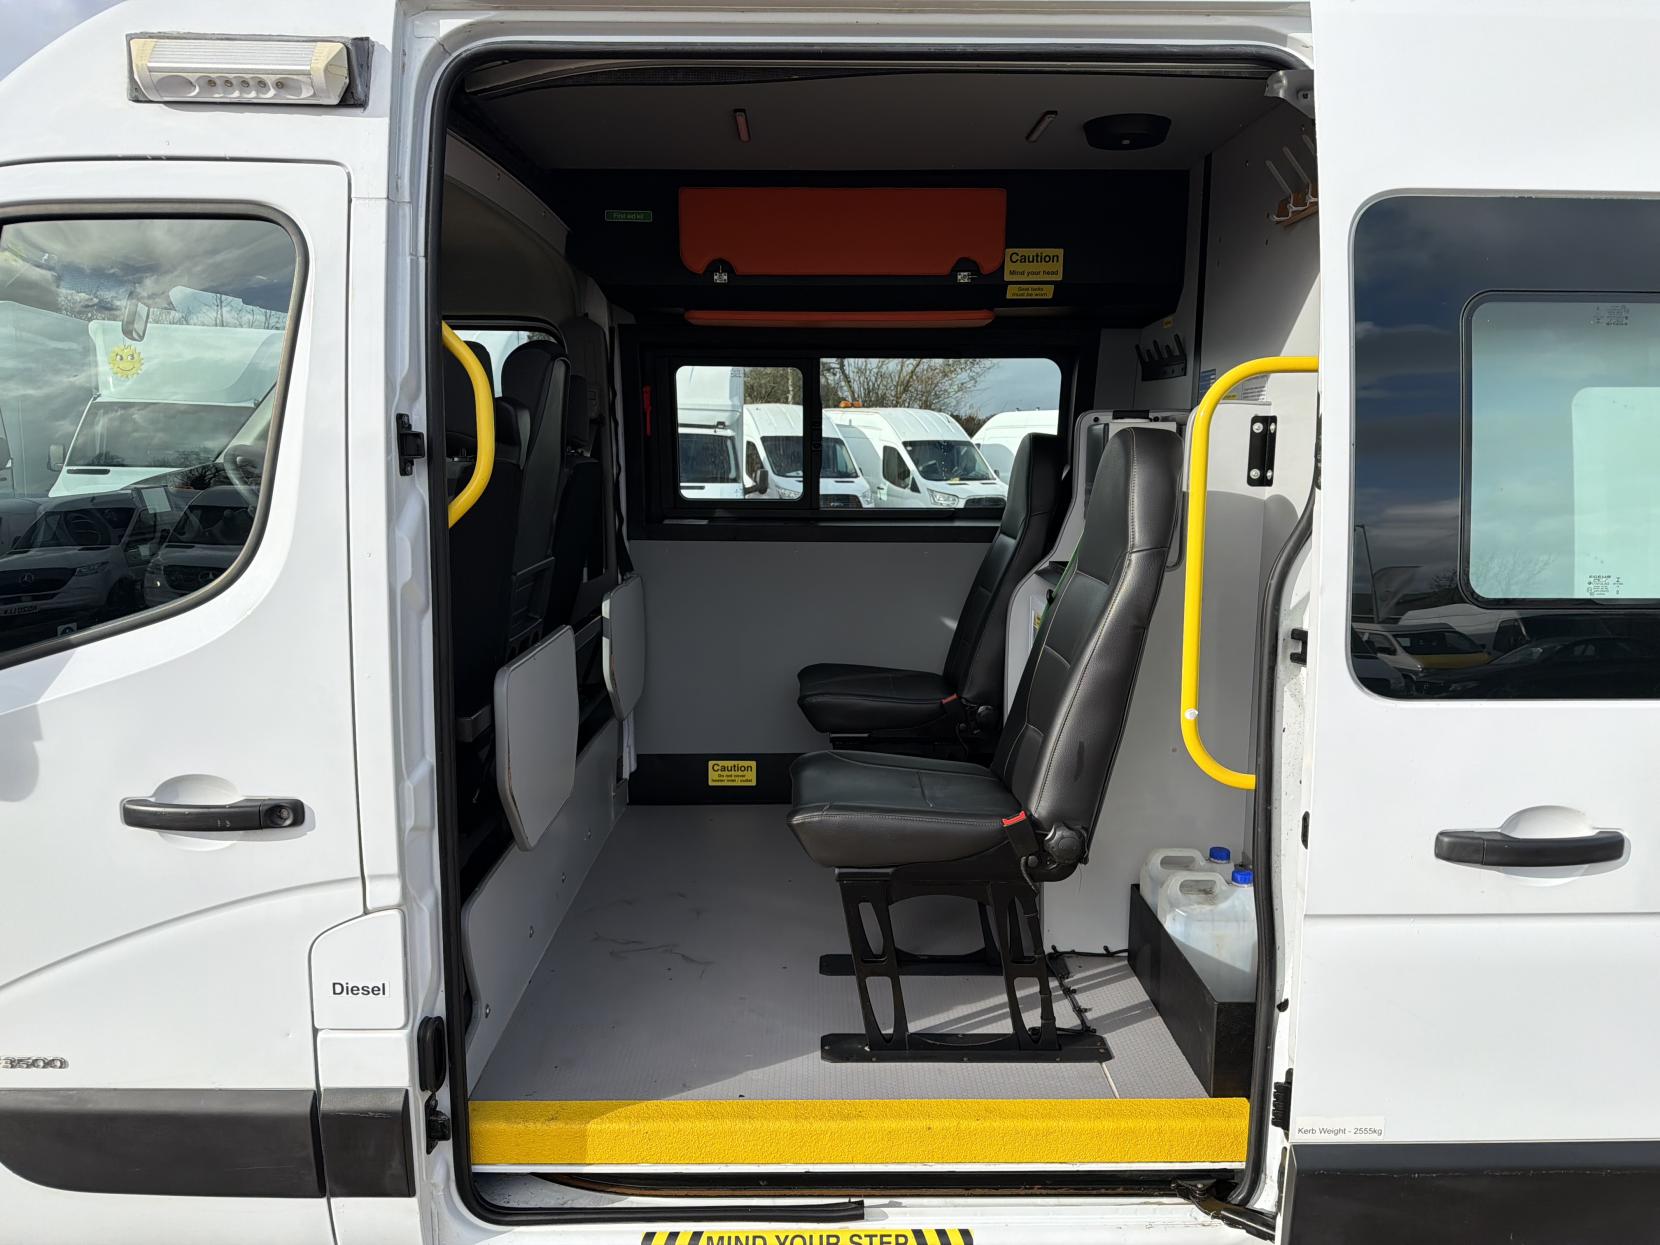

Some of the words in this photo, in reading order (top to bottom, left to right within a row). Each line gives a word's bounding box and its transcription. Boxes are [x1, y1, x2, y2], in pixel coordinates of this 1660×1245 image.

[1009, 252, 1059, 263] Caution
[712, 764, 752, 772] Caution
[332, 982, 386, 996] Diesel
[0, 1057, 69, 1069] 3500
[1319, 1128, 1346, 1136] Weight
[1354, 1128, 1382, 1136] 2555kg
[706, 1235, 767, 1245] MIND
[775, 1235, 840, 1245] YOUR
[849, 1234, 909, 1245] STEP
